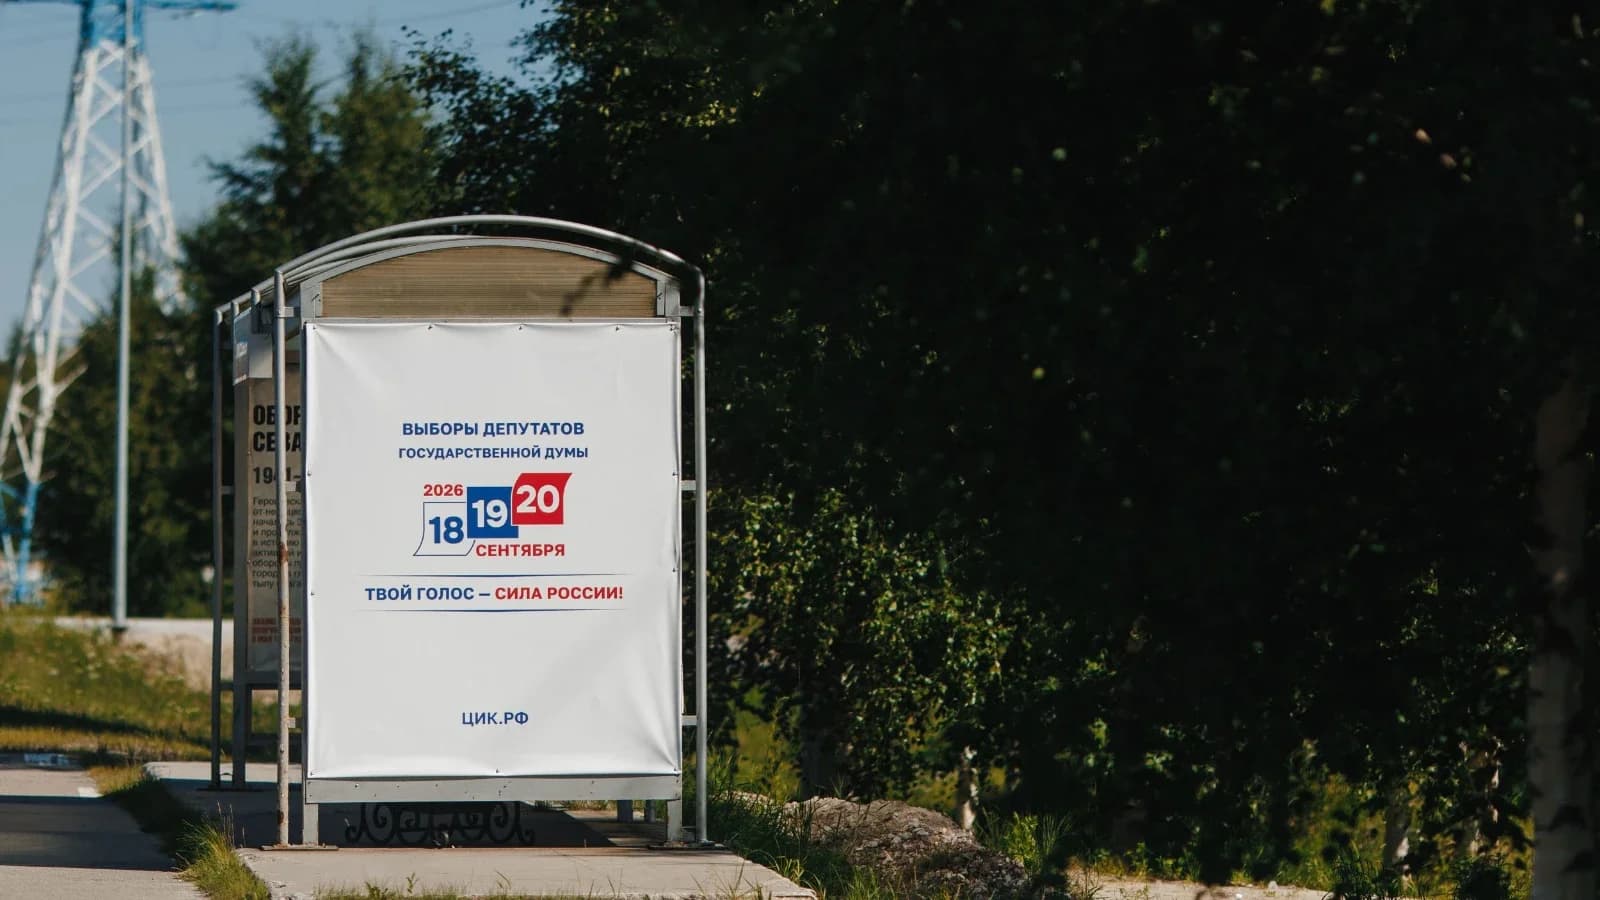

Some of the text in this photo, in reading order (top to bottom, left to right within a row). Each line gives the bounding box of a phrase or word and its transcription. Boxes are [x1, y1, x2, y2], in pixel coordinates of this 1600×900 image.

[403, 423, 584, 437] ВЫБОРЫ ДЕПУТАТОВ
[399, 445, 587, 459] ГОСУДАРСТВЕННОЙ ДУМЫ
[424, 484, 463, 496] 2026
[429, 485, 559, 544] 18 19 20
[476, 544, 564, 556] СЕНТЯБРЯ
[365, 585, 411, 600] ТВОЙ
[418, 588, 474, 600] ГОЛОС
[496, 588, 542, 599] СИЛА
[548, 587, 622, 599] РОССИИ!
[463, 712, 528, 726] ЦИК.РФ
